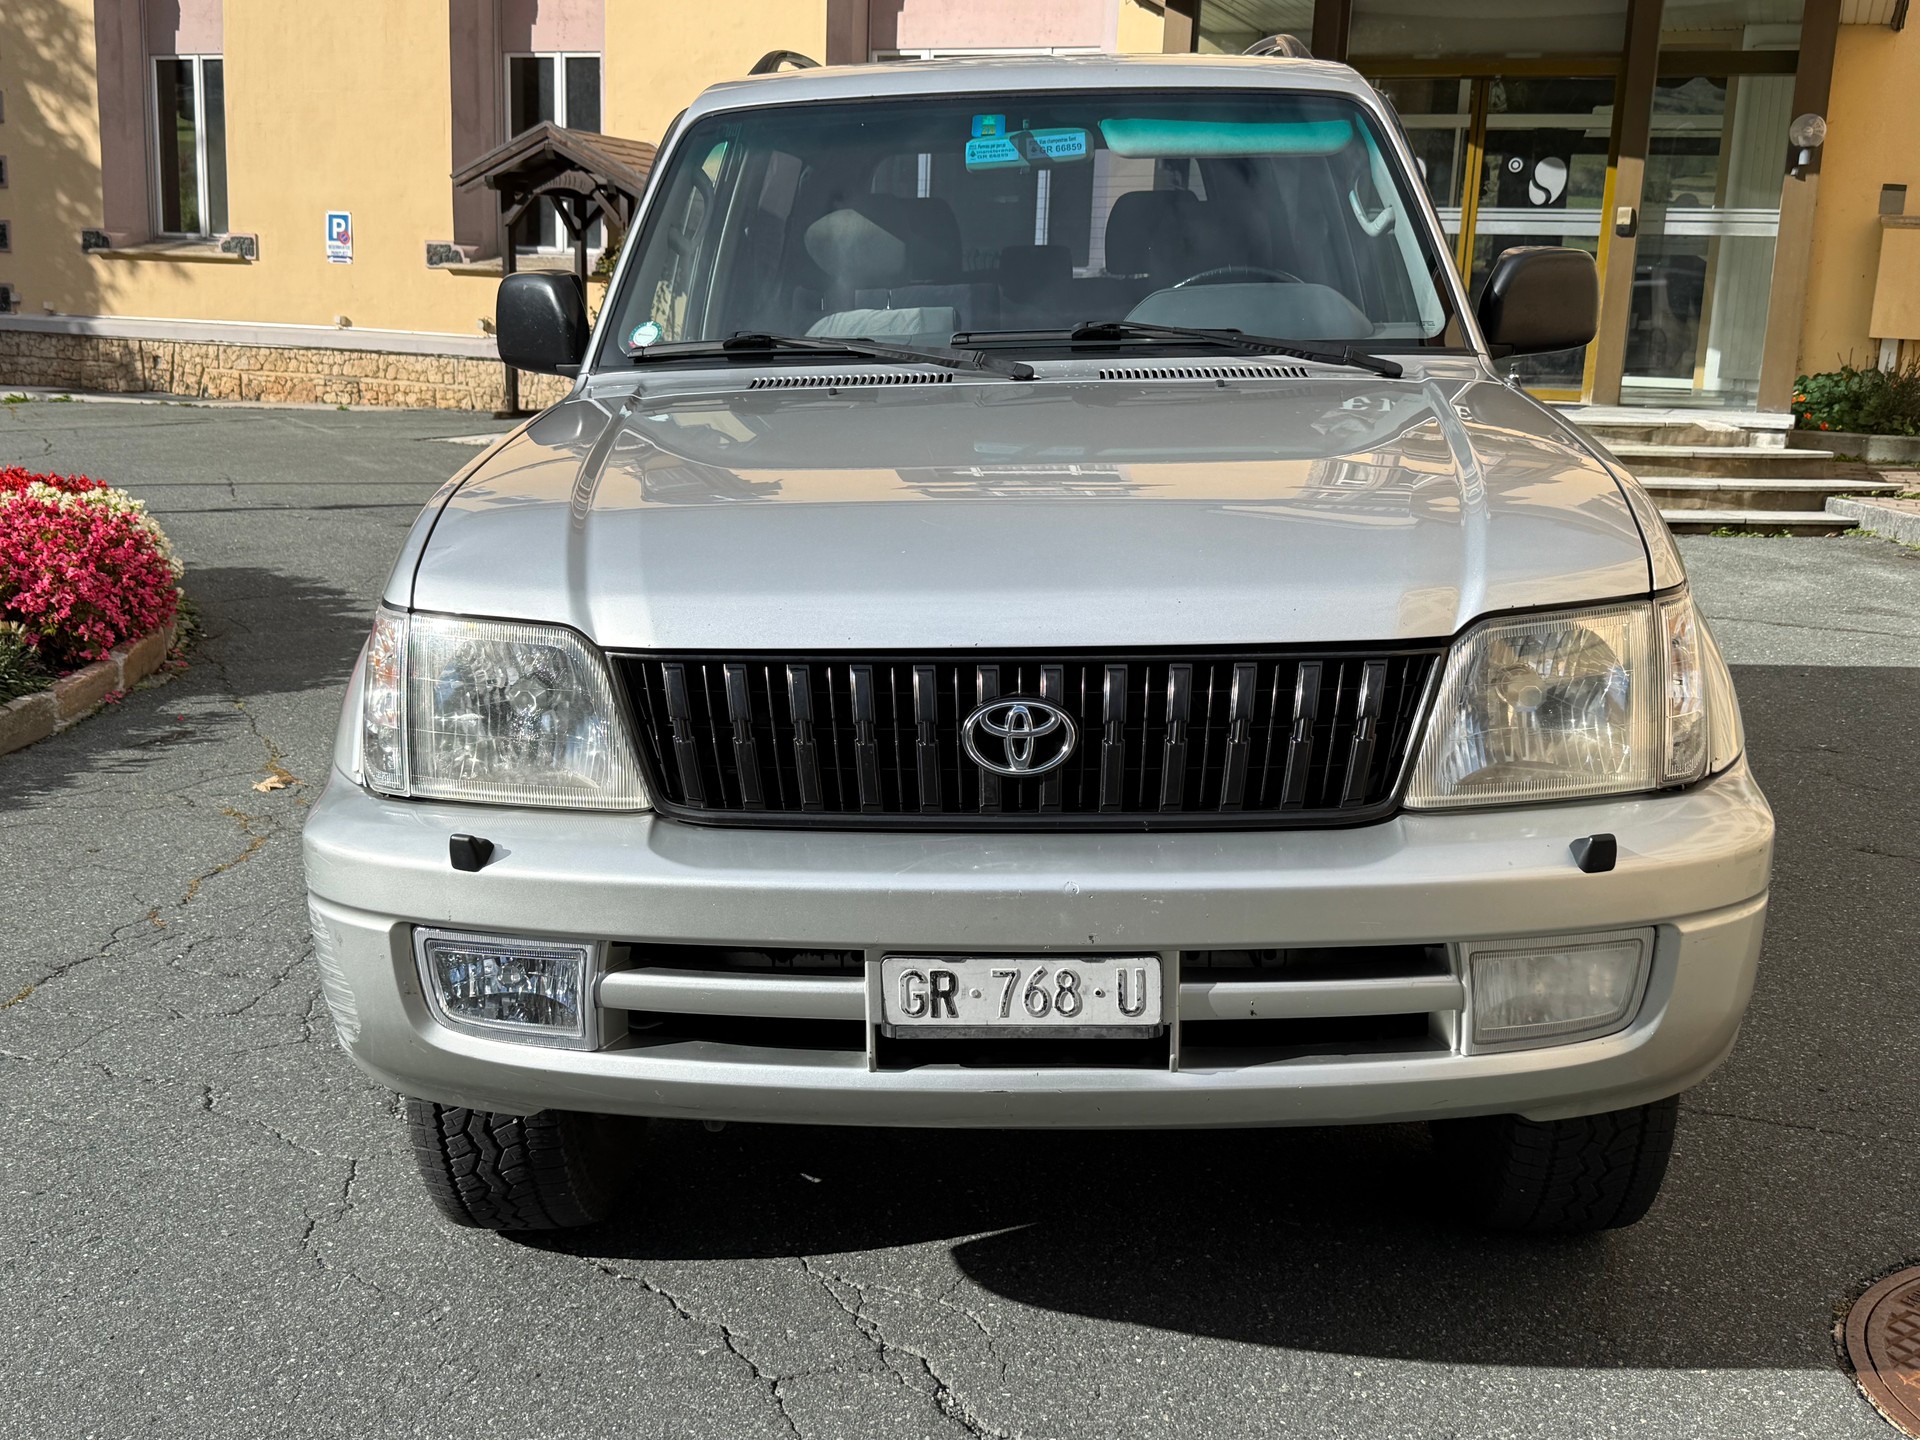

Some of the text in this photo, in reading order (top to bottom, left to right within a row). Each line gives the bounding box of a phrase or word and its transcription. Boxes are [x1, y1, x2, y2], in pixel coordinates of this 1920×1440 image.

[1039, 143, 1082, 154] GR 66859
[332, 218, 346, 239] P
